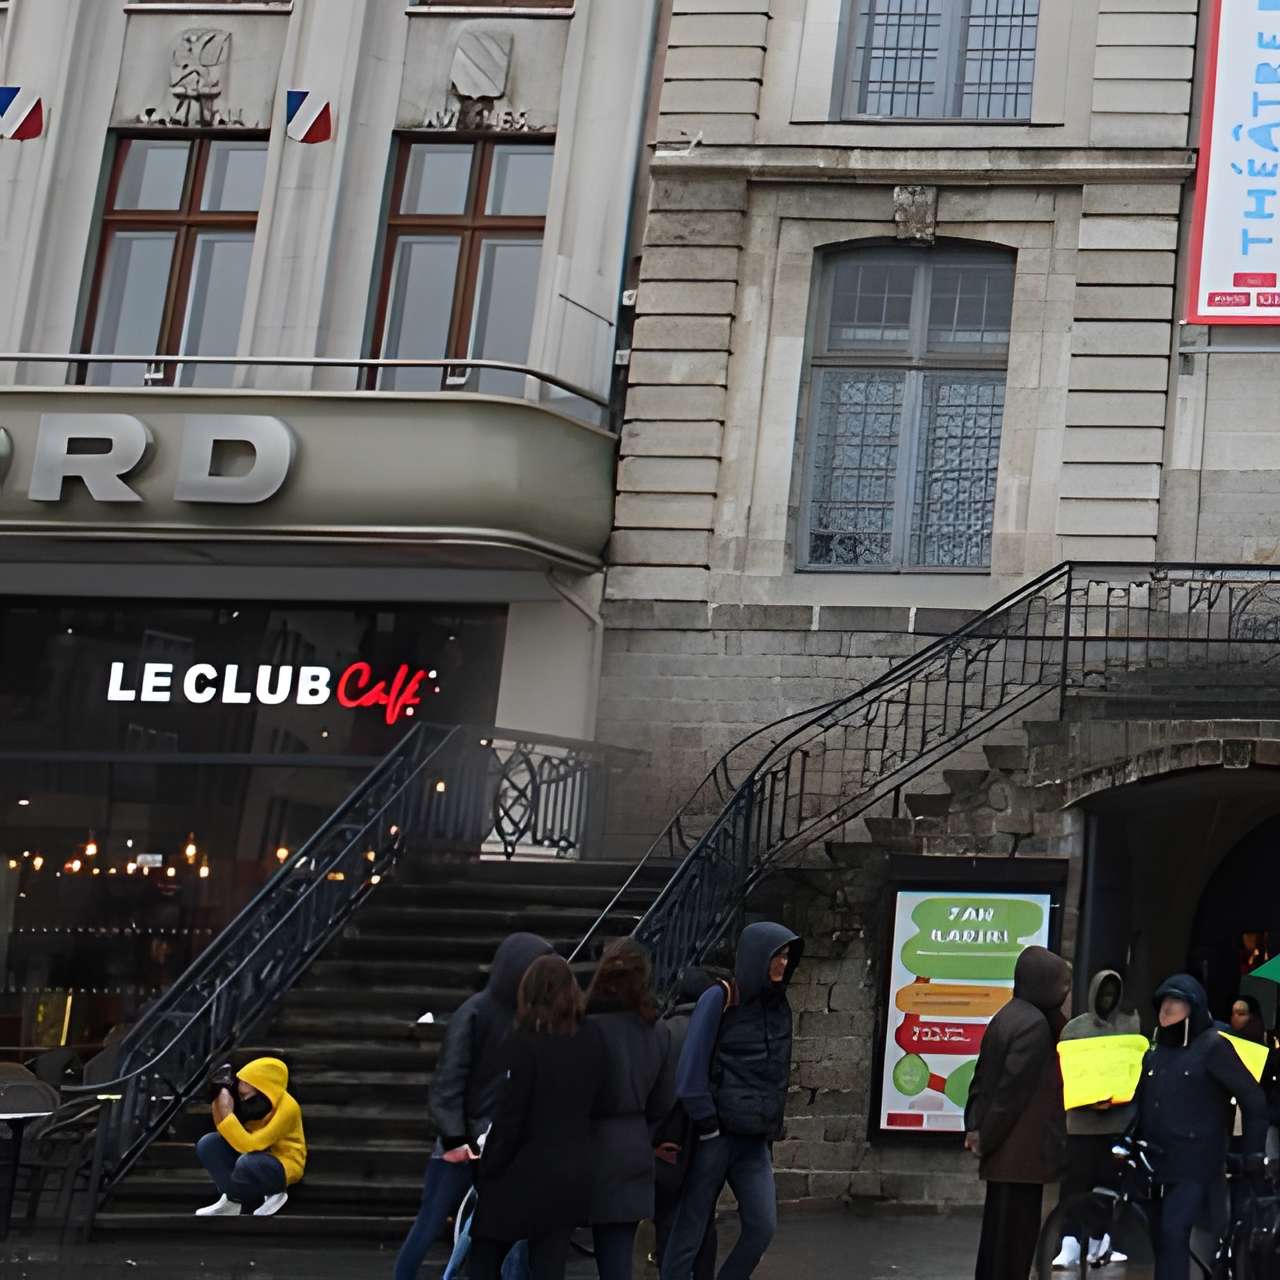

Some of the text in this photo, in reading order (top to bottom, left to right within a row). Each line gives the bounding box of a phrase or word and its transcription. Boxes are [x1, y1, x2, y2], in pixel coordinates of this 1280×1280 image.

[0, 413, 298, 504] RD
[107, 661, 174, 702] LE
[183, 663, 331, 705] CLUB
